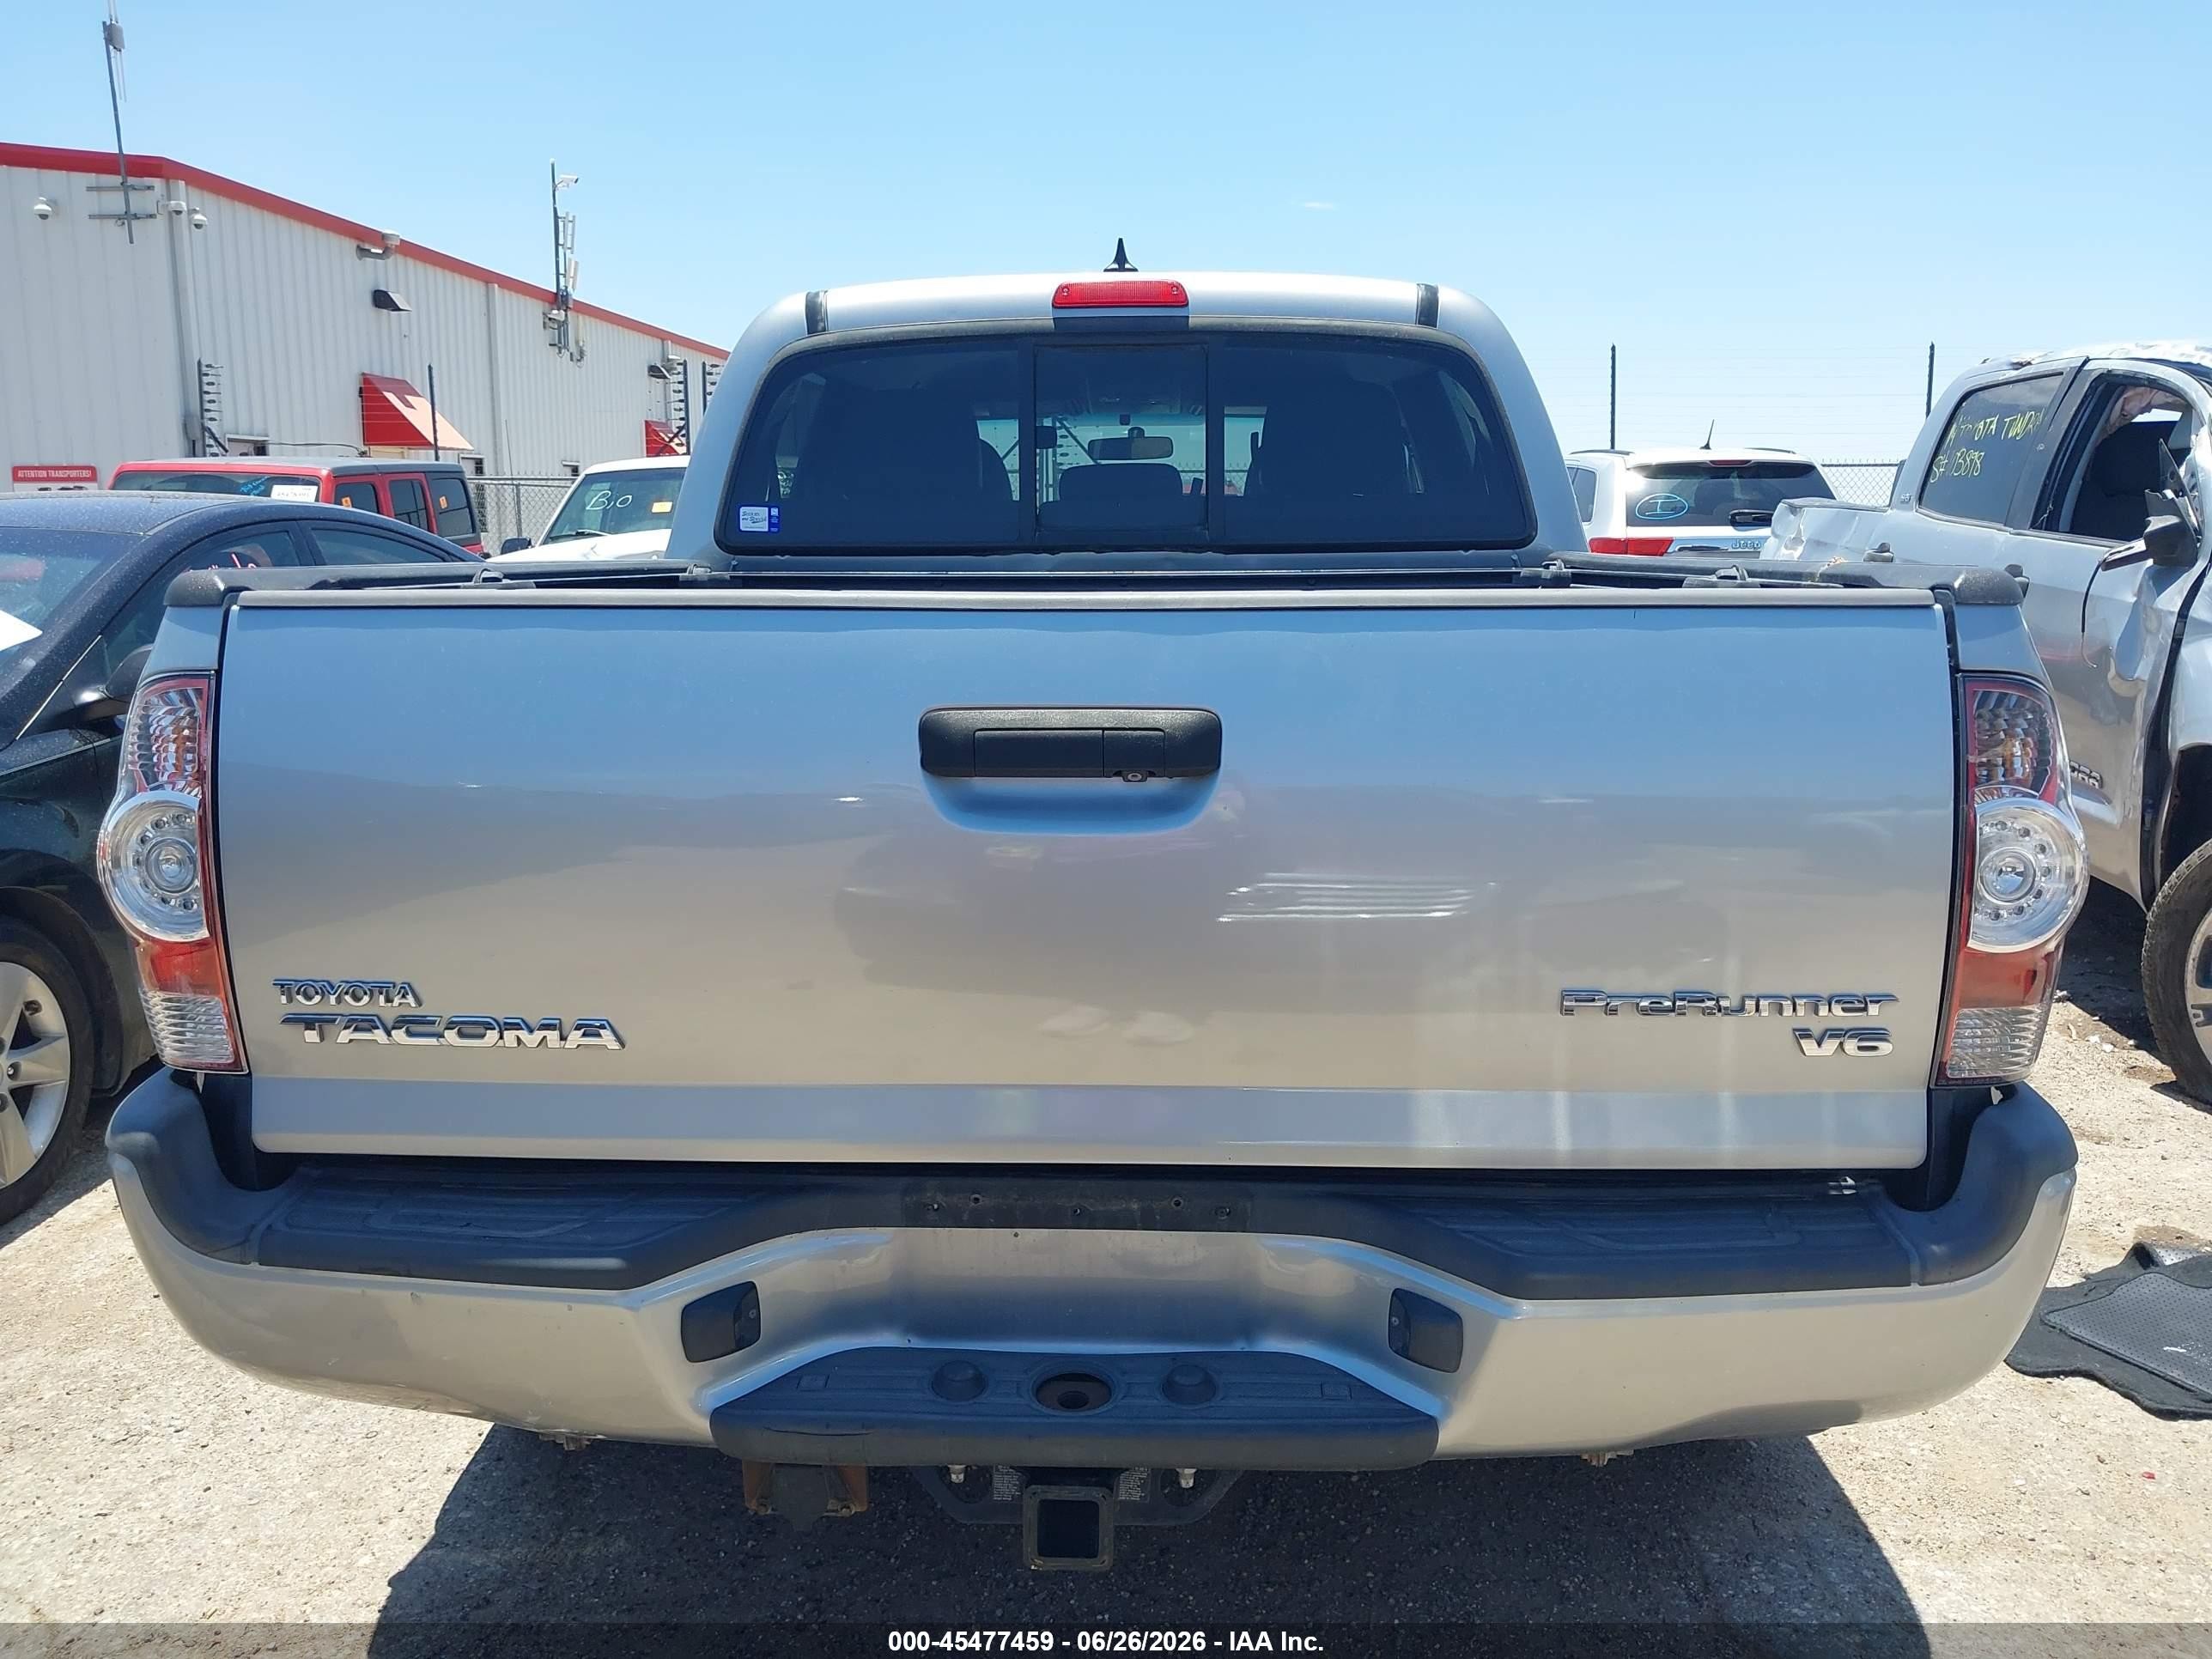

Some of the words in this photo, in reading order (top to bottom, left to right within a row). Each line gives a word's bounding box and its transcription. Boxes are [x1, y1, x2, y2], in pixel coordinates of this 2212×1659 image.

[18, 470, 47, 478] ATTENTION
[1731, 538, 1762, 550] Jeep
[272, 979, 425, 1008] TOYOTA
[1559, 989, 1899, 1018] PreRunner
[280, 1013, 626, 1051] TACOMA
[1792, 1027, 1894, 1057] V6
